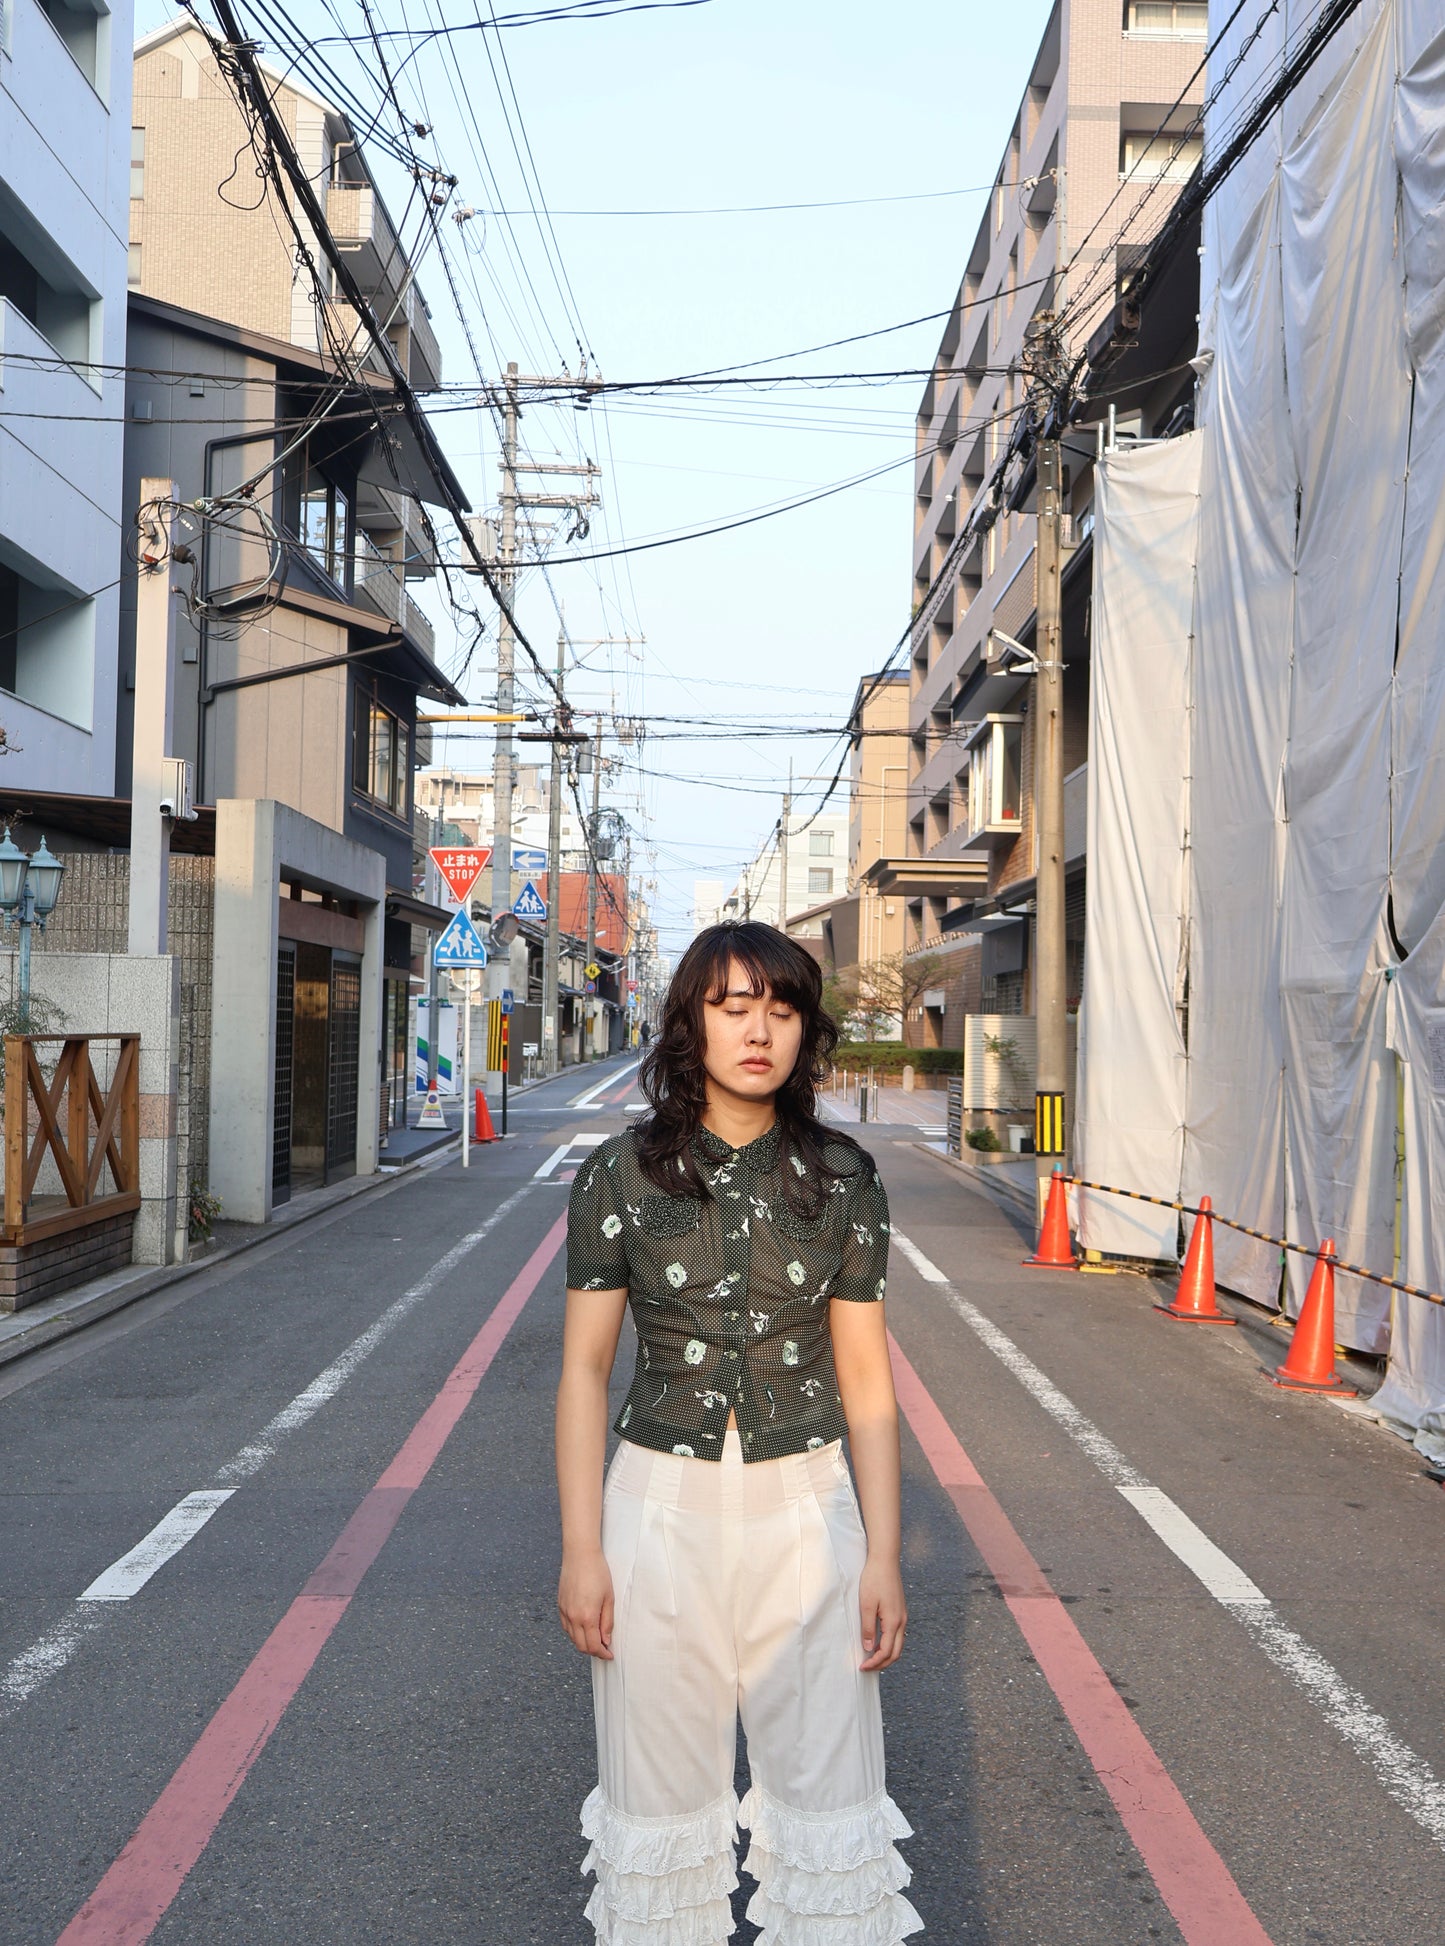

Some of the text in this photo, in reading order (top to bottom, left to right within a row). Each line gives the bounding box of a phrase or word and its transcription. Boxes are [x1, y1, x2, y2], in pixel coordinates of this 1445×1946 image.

[443, 854, 479, 867] 止まれ
[449, 869, 475, 880] STOP
